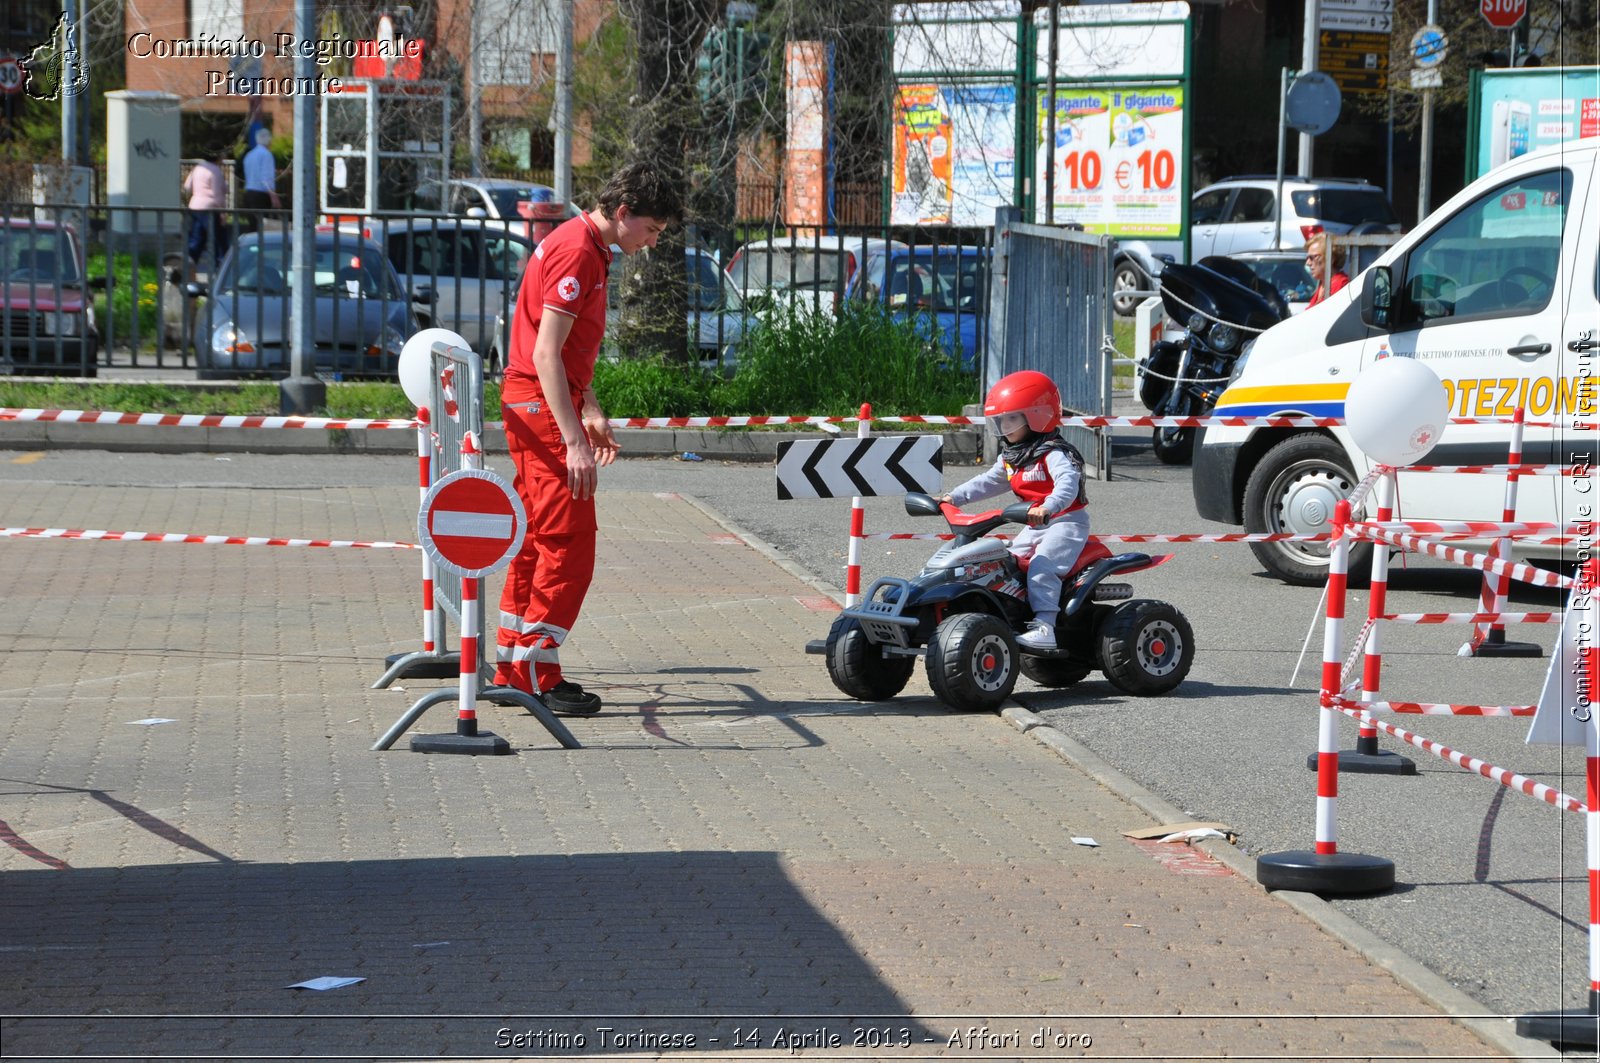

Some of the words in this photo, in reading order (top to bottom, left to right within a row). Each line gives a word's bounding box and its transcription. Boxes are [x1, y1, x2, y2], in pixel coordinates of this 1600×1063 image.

[1484, 0, 1524, 13] STOP
[1, 67, 18, 82] 30
[1054, 95, 1101, 111] gigante
[1114, 92, 1122, 107] Il
[1125, 93, 1175, 110] gigante
[1064, 151, 1102, 190] 10
[1115, 160, 1131, 190] €
[1137, 149, 1175, 190] 10
[1421, 349, 1452, 360] SETTIMO
[1453, 348, 1488, 359] TORINESE
[1488, 348, 1503, 358] (TO)
